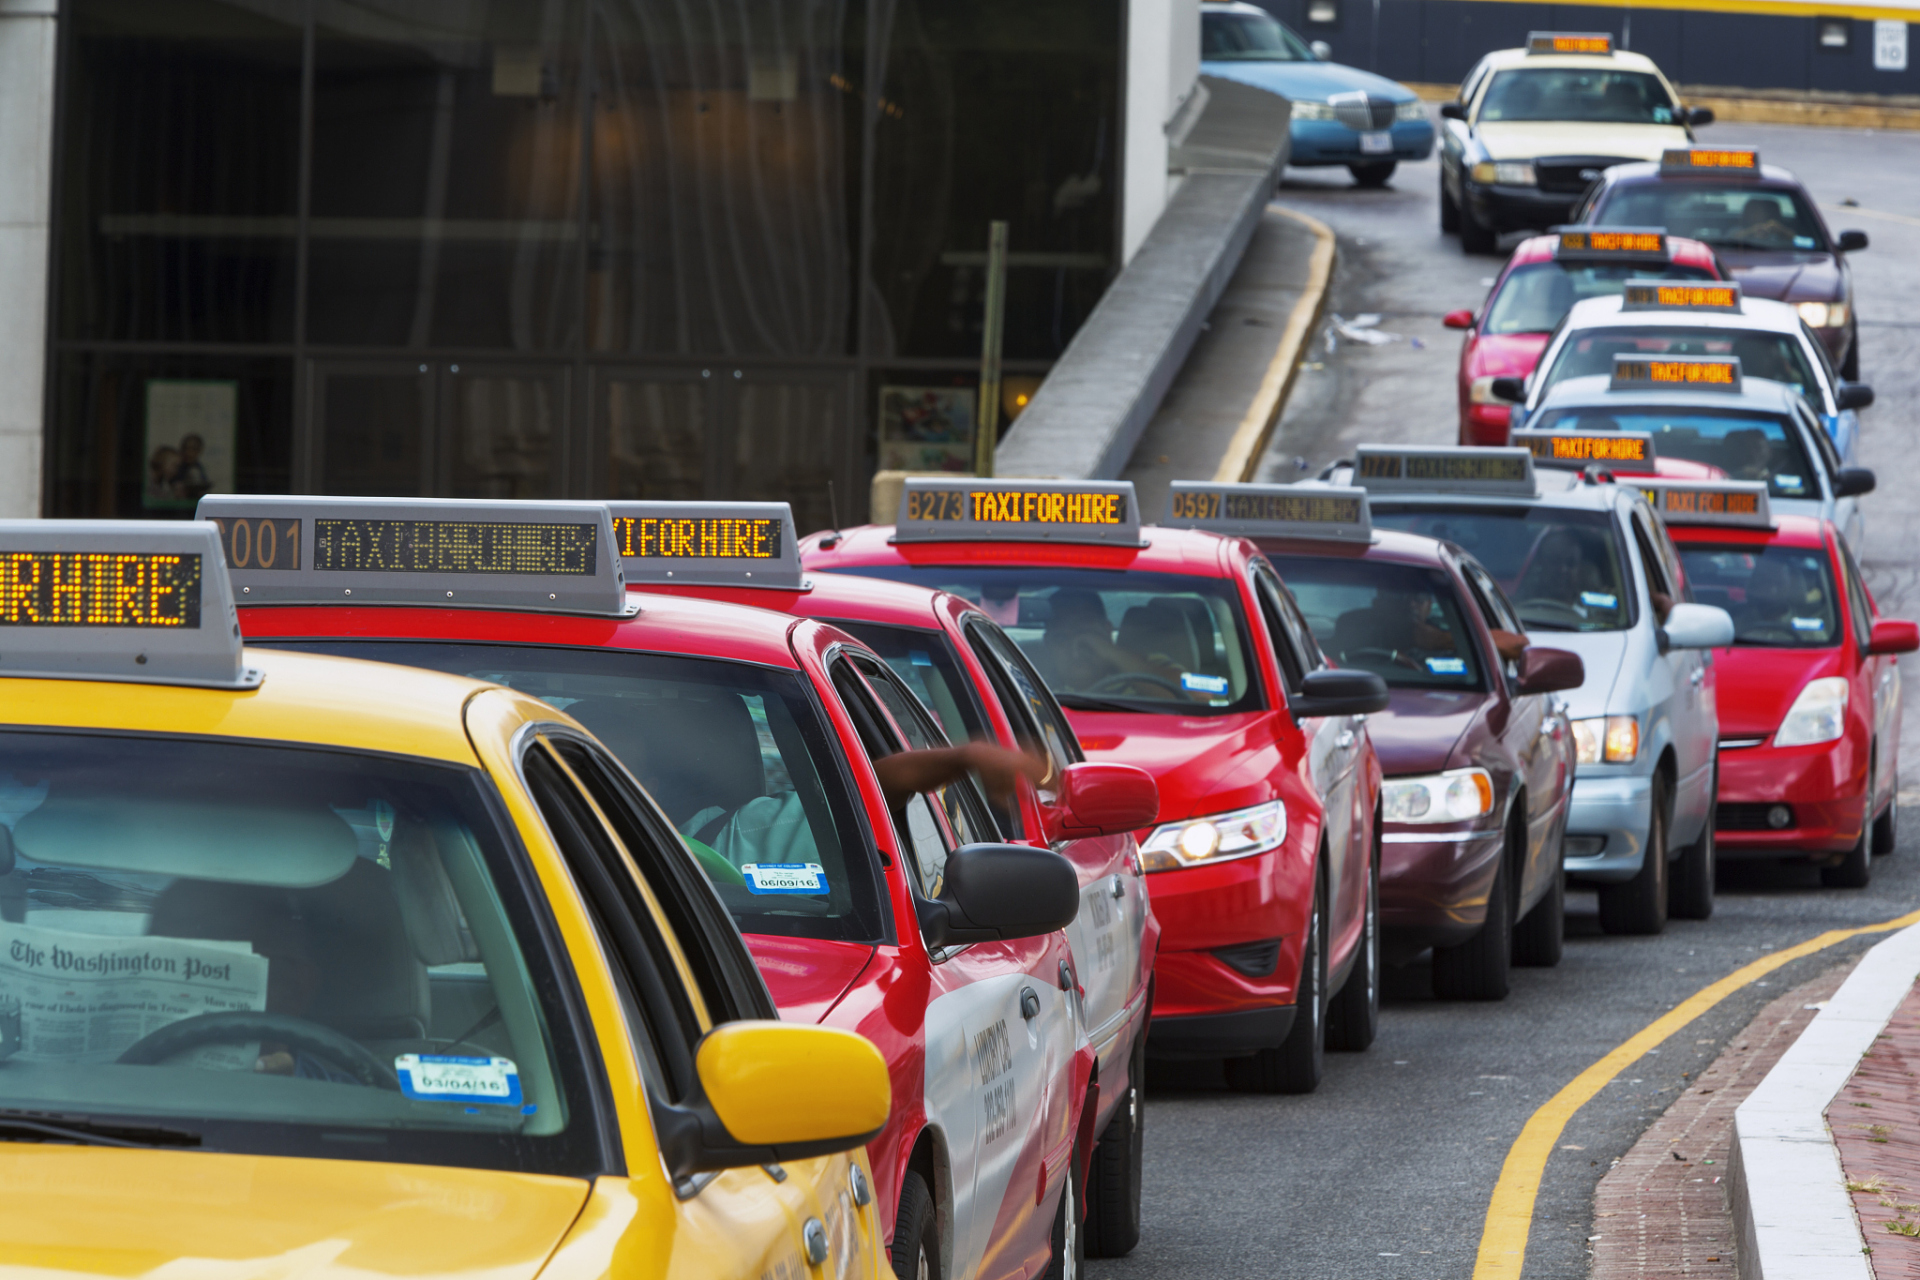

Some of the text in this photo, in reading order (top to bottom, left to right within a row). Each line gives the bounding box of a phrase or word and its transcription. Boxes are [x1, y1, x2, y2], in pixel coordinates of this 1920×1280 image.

[908, 491, 963, 520] B273
[1173, 493, 1221, 518] D597
[10, 939, 231, 980] The Washington Post
[422, 1077, 500, 1091] 03/04/16
